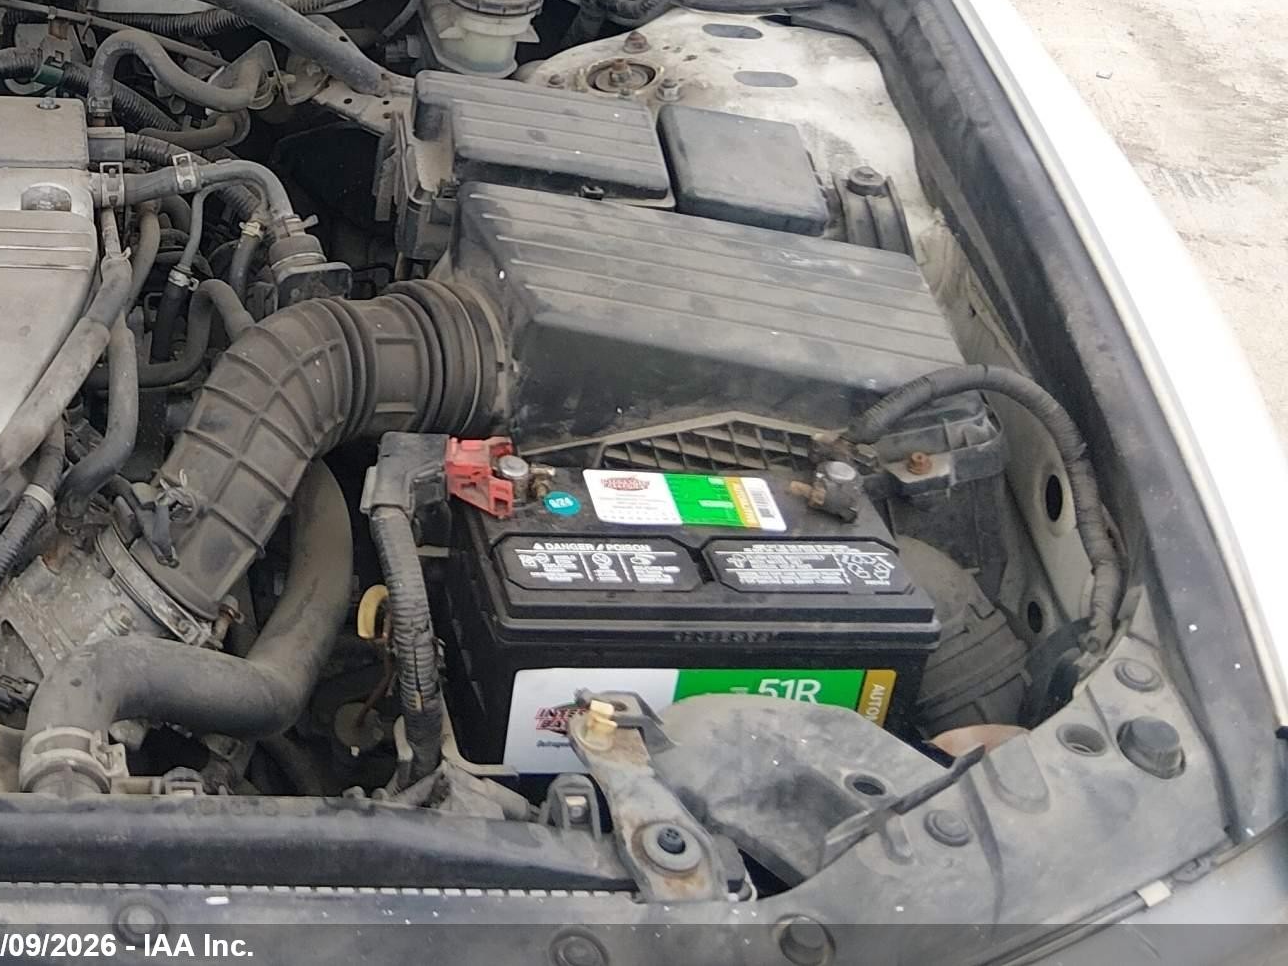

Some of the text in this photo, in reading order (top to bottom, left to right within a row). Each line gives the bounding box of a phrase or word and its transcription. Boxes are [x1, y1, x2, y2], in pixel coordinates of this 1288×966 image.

[544, 542, 594, 551] DANGER
[606, 544, 651, 552] POISON
[758, 678, 822, 705] 51R
